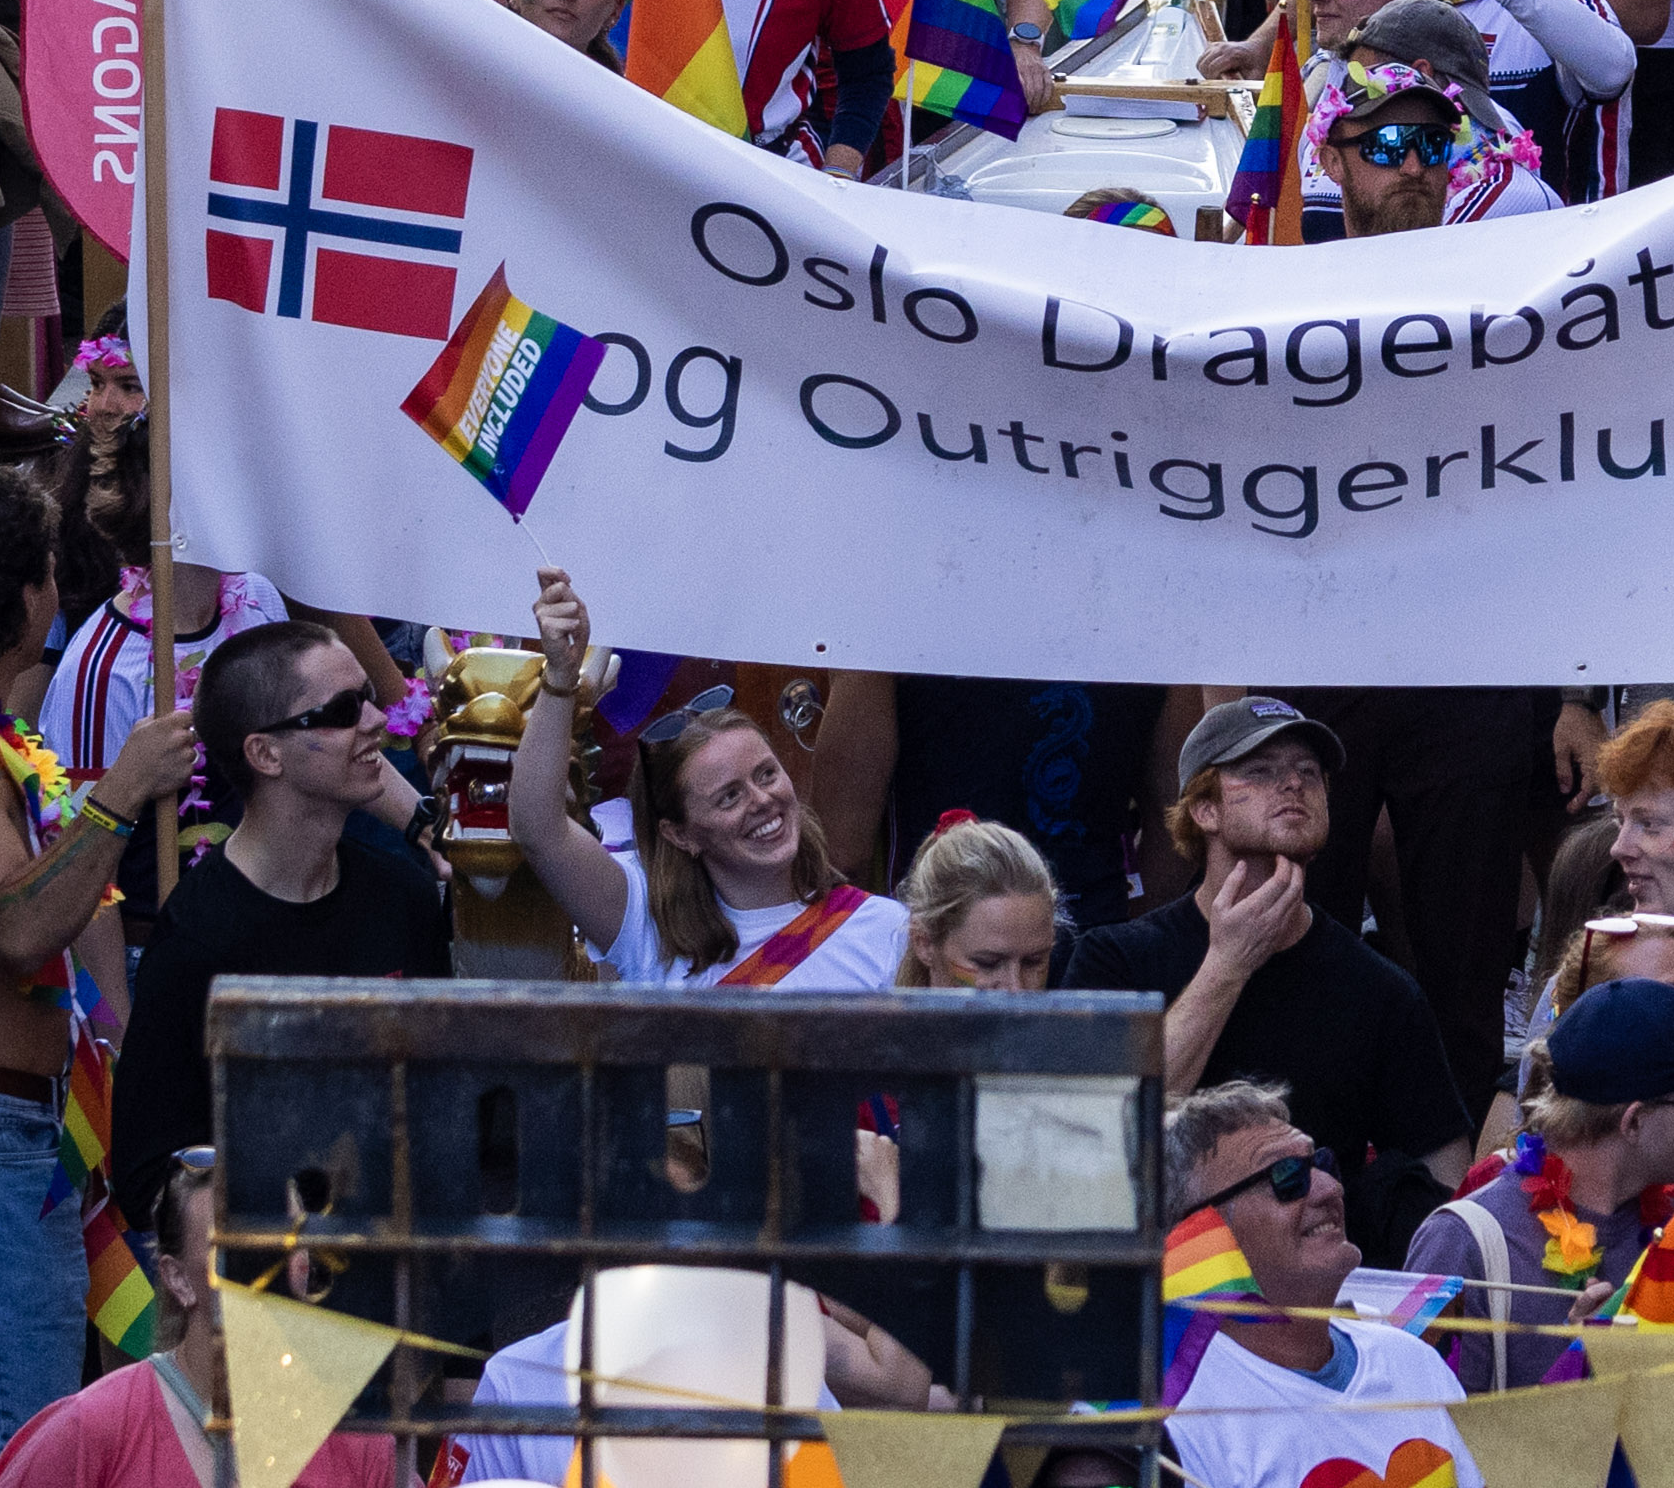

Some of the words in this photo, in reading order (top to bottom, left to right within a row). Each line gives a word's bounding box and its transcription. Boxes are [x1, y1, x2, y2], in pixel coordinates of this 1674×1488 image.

[689, 199, 980, 344] Oslo
[458, 319, 523, 446] EVERYONE
[477, 336, 543, 460] INCLUDED
[583, 330, 743, 463] og
